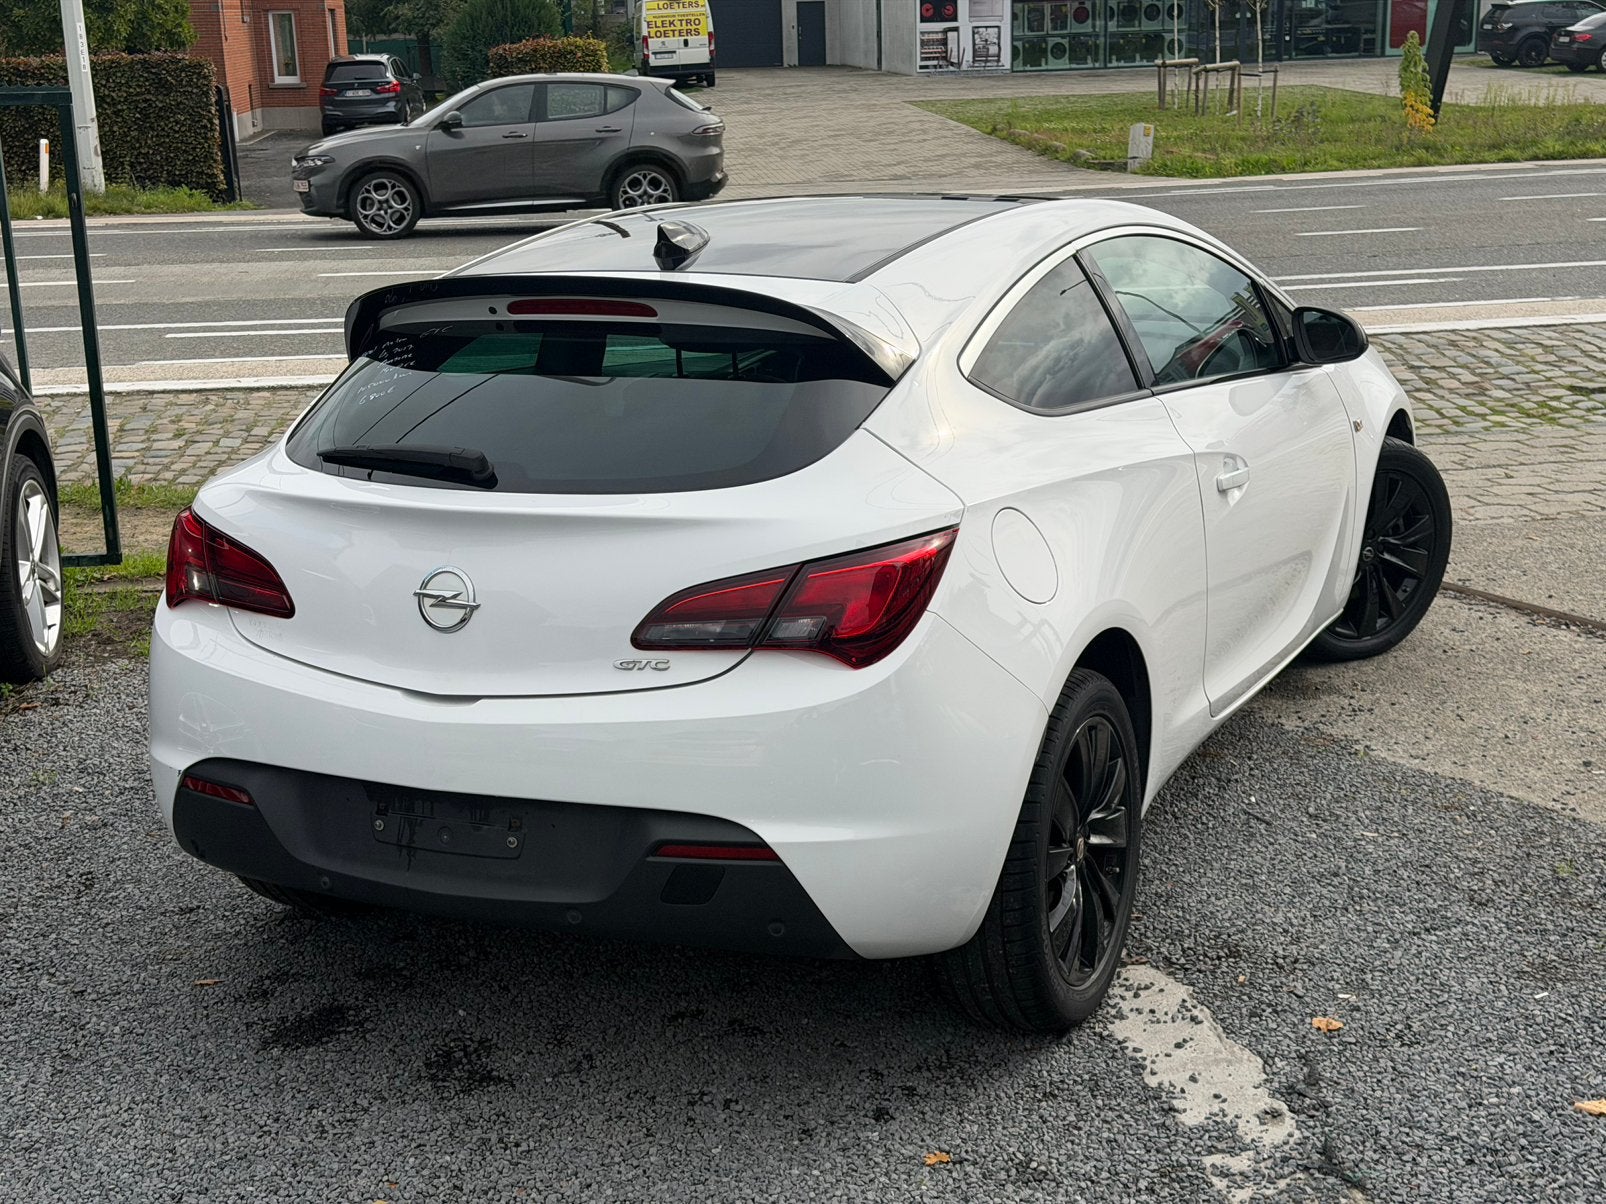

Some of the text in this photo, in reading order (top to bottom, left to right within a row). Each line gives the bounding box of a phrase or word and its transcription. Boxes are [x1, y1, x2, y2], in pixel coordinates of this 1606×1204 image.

[657, 0, 700, 10] LOETERS
[647, 18, 702, 29] ELEKTRO
[648, 28, 701, 39] LOETERS
[613, 659, 671, 671] GTC
